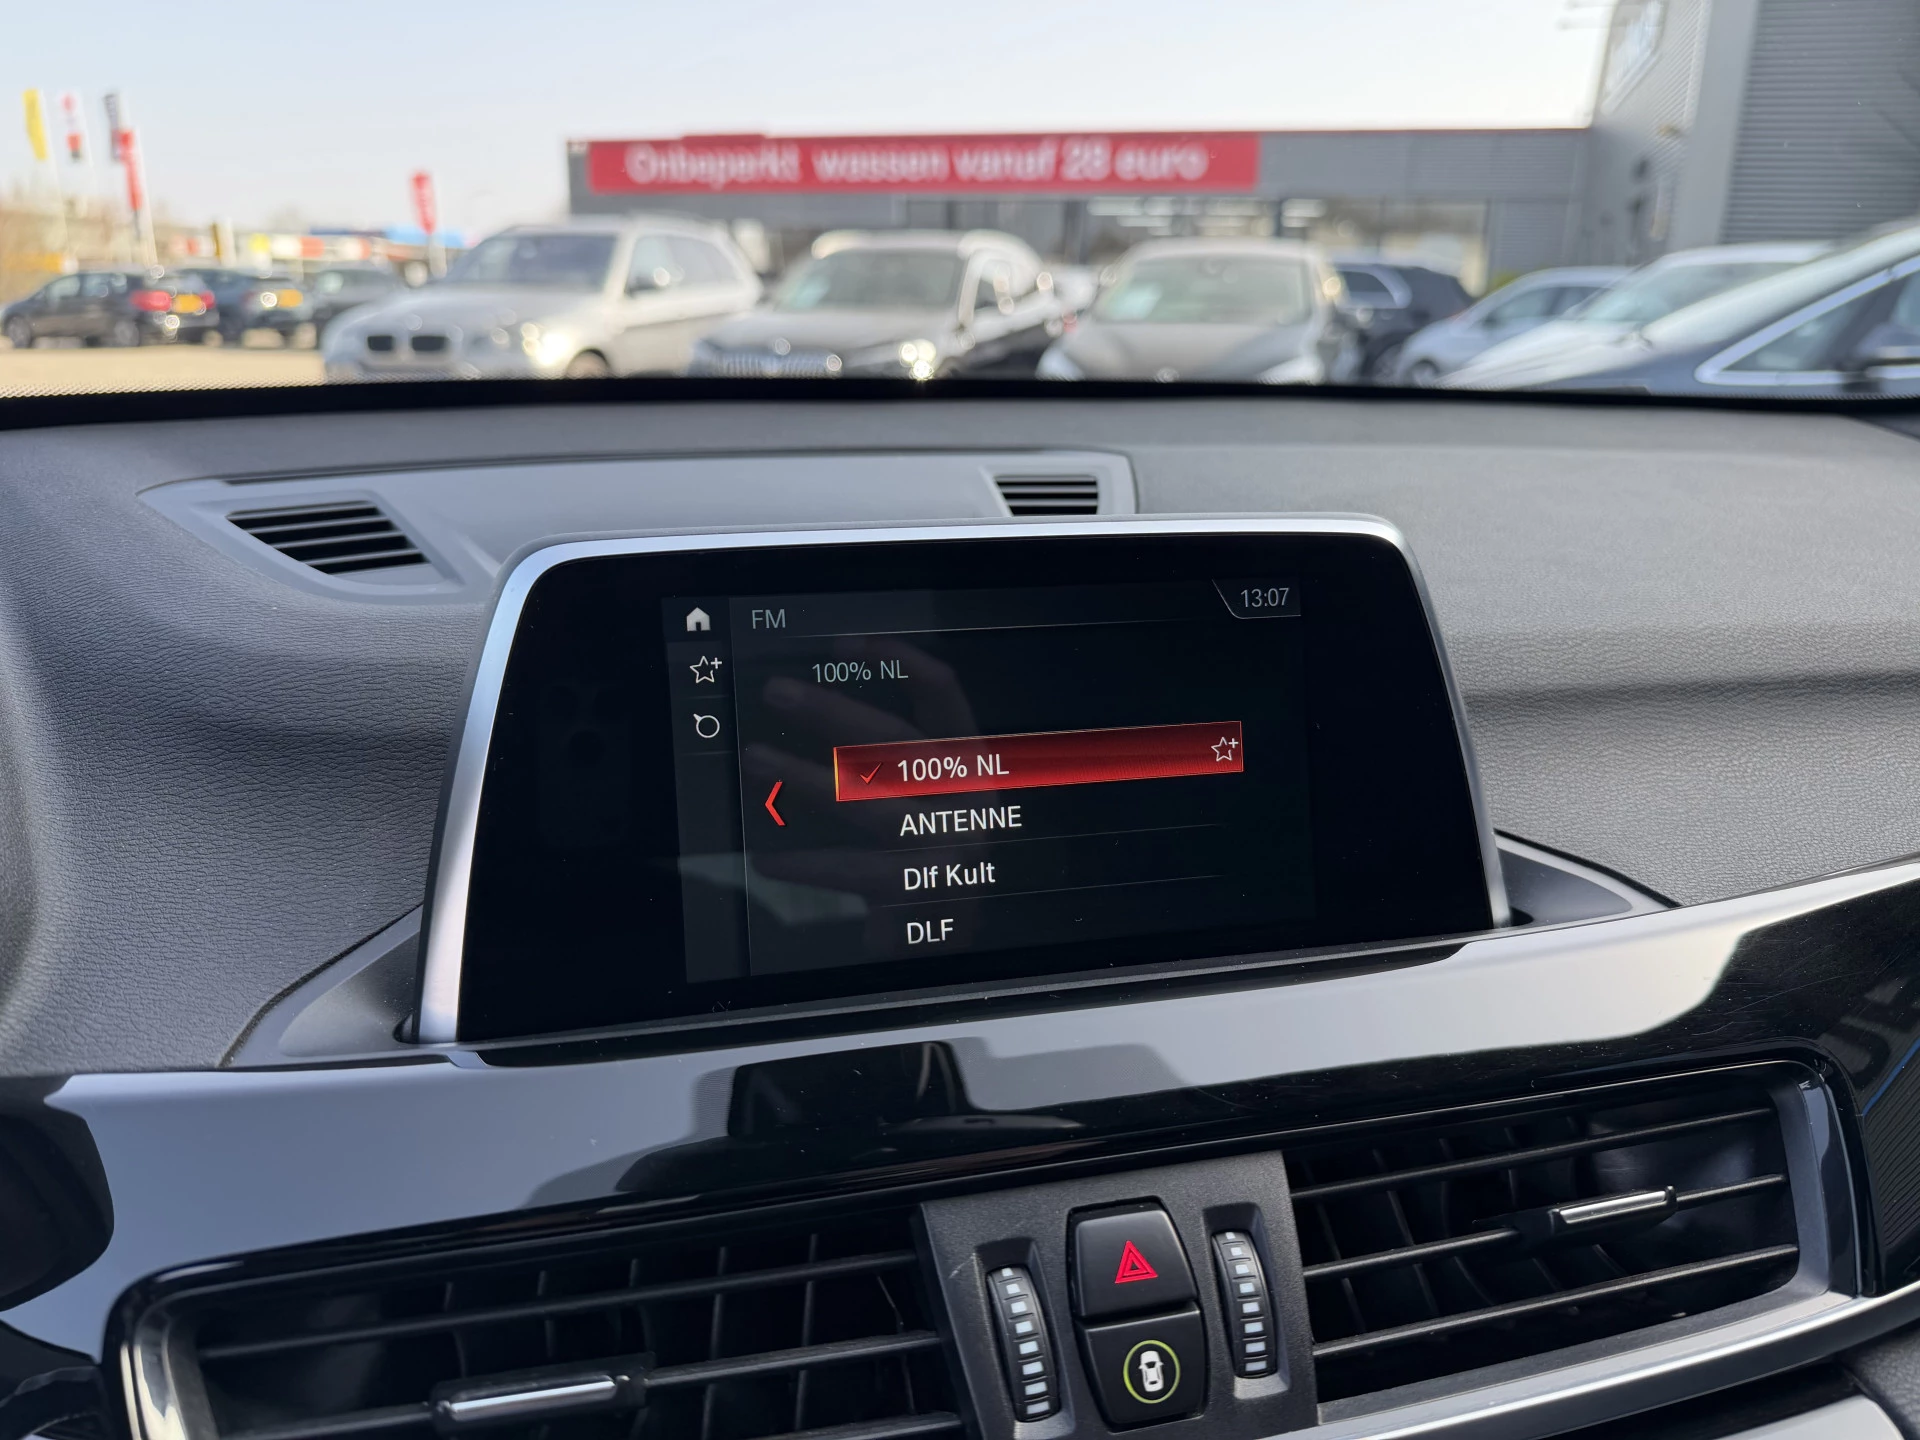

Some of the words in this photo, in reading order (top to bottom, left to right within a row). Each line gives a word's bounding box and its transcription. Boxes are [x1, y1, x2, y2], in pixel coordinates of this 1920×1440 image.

[624, 142, 800, 190] Onbeperkt
[812, 147, 949, 183] wassen
[953, 138, 1057, 183] vanaf
[1114, 142, 1209, 182] euro
[1239, 587, 1290, 609] 13:07
[750, 608, 787, 630] FM
[811, 661, 873, 684] 100%
[880, 658, 909, 680] NL
[897, 756, 969, 782] 100%
[976, 753, 1010, 777] NL
[899, 805, 1023, 837] ANTENNE
[903, 865, 940, 891] Dlf
[945, 861, 997, 887] Kult
[906, 918, 955, 945] DLF
